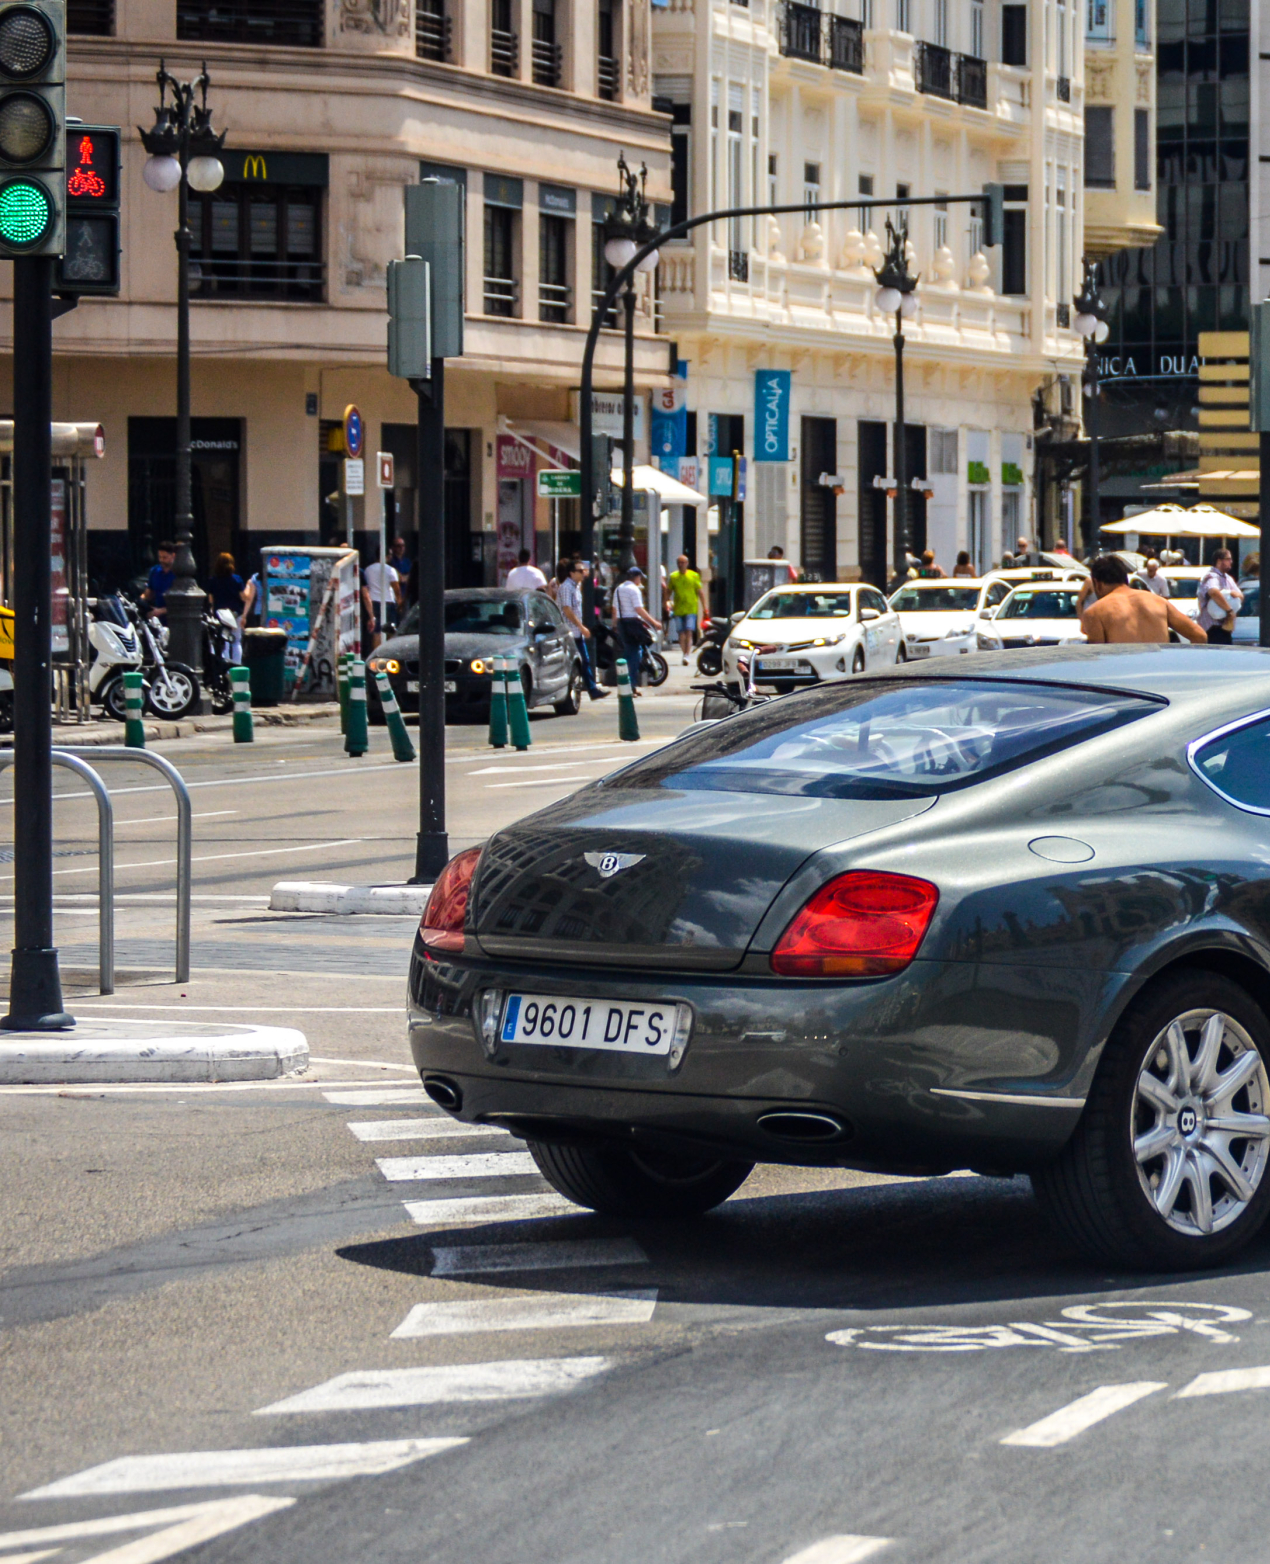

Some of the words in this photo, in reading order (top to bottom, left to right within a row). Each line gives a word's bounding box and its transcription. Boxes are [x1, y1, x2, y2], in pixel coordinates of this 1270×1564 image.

[1098, 356, 1137, 375] NICA
[1160, 355, 1206, 374] DUA
[189, 440, 239, 449] cDonald's
[522, 1002, 592, 1040] 9601
[604, 1008, 664, 1046] DFS
